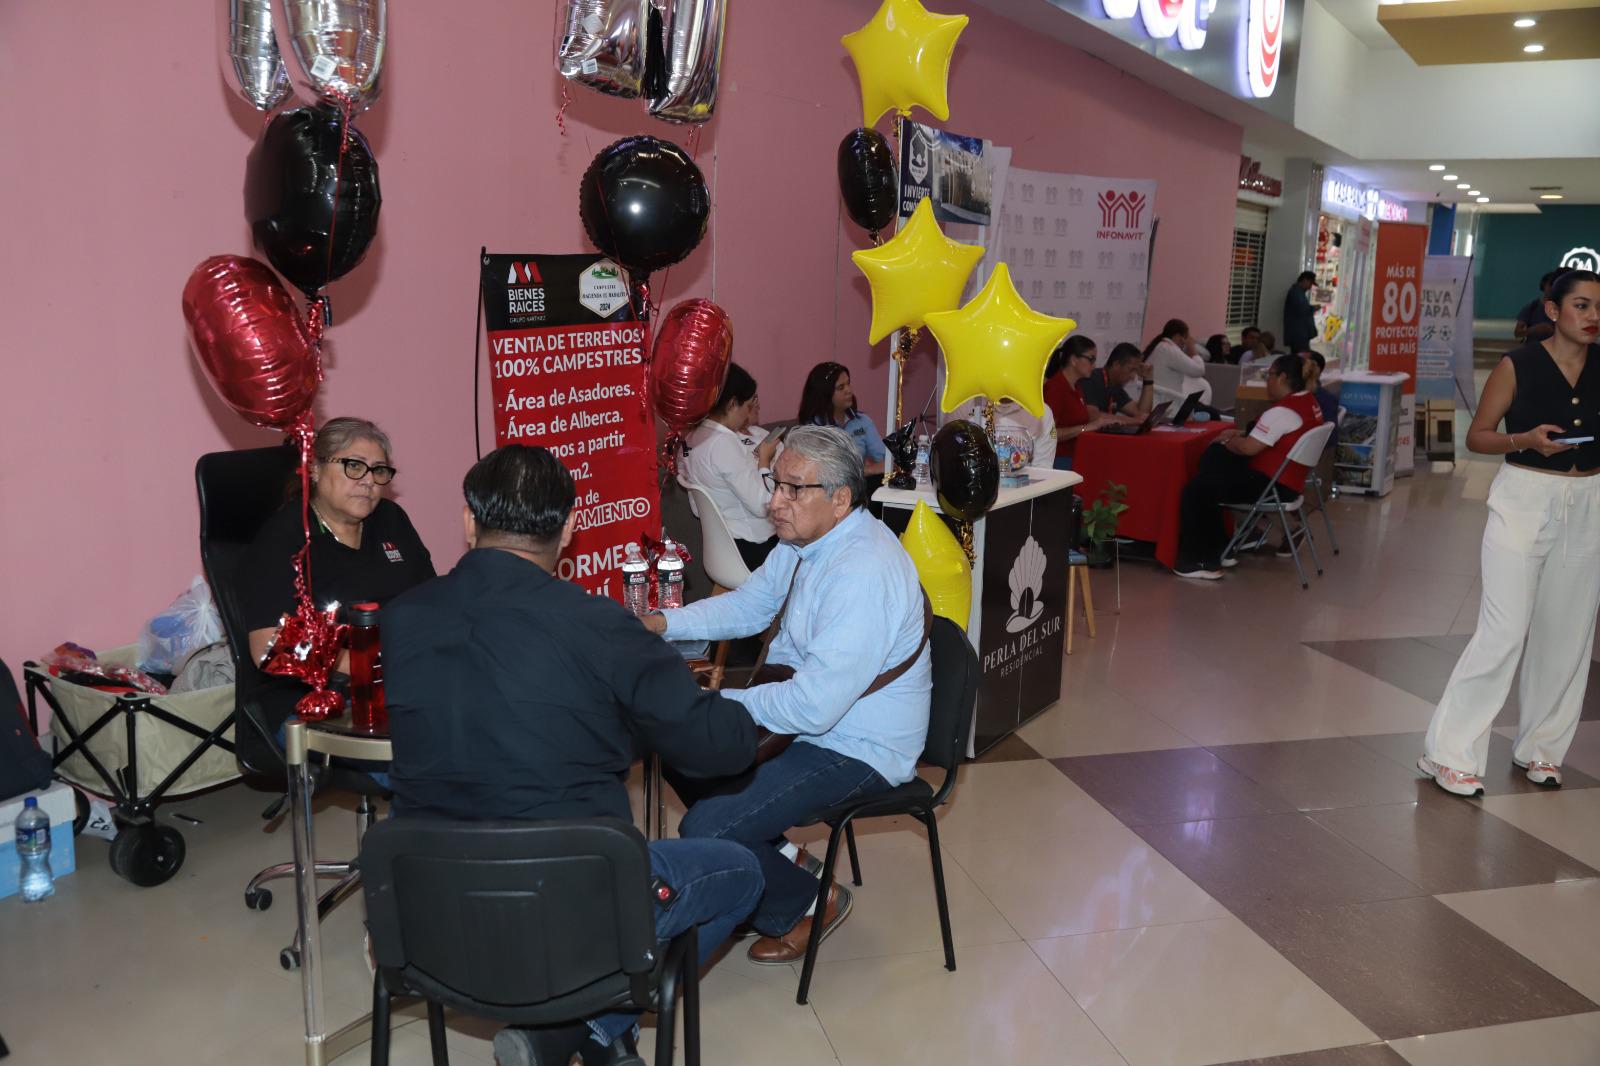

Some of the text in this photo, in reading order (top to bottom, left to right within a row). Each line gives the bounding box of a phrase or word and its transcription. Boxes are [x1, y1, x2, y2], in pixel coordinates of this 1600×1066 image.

[1096, 230, 1143, 240] INFONAVIT
[1386, 262, 1415, 278] MÁS DE
[508, 288, 545, 301] BIENES
[509, 300, 545, 313] RAICES
[1382, 281, 1417, 323] 80
[599, 303, 611, 312] 2024
[493, 328, 641, 355] VENTA DE TERRENOS
[1376, 326, 1418, 339] PROYECTOS
[1376, 343, 1388, 355] EN
[1400, 339, 1416, 354] PAÍS
[495, 348, 642, 379] 100% CAMPESTRES
[505, 382, 635, 412] Área de Asadores.
[507, 410, 624, 439] Área de Alberca.
[577, 441, 585, 454] a
[588, 430, 626, 455] partir
[585, 489, 600, 506] de
[572, 497, 651, 533] AMIENTO
[984, 615, 1062, 673] PERLA DEL SUR
[1000, 647, 1043, 678] RESIDENCIAL
